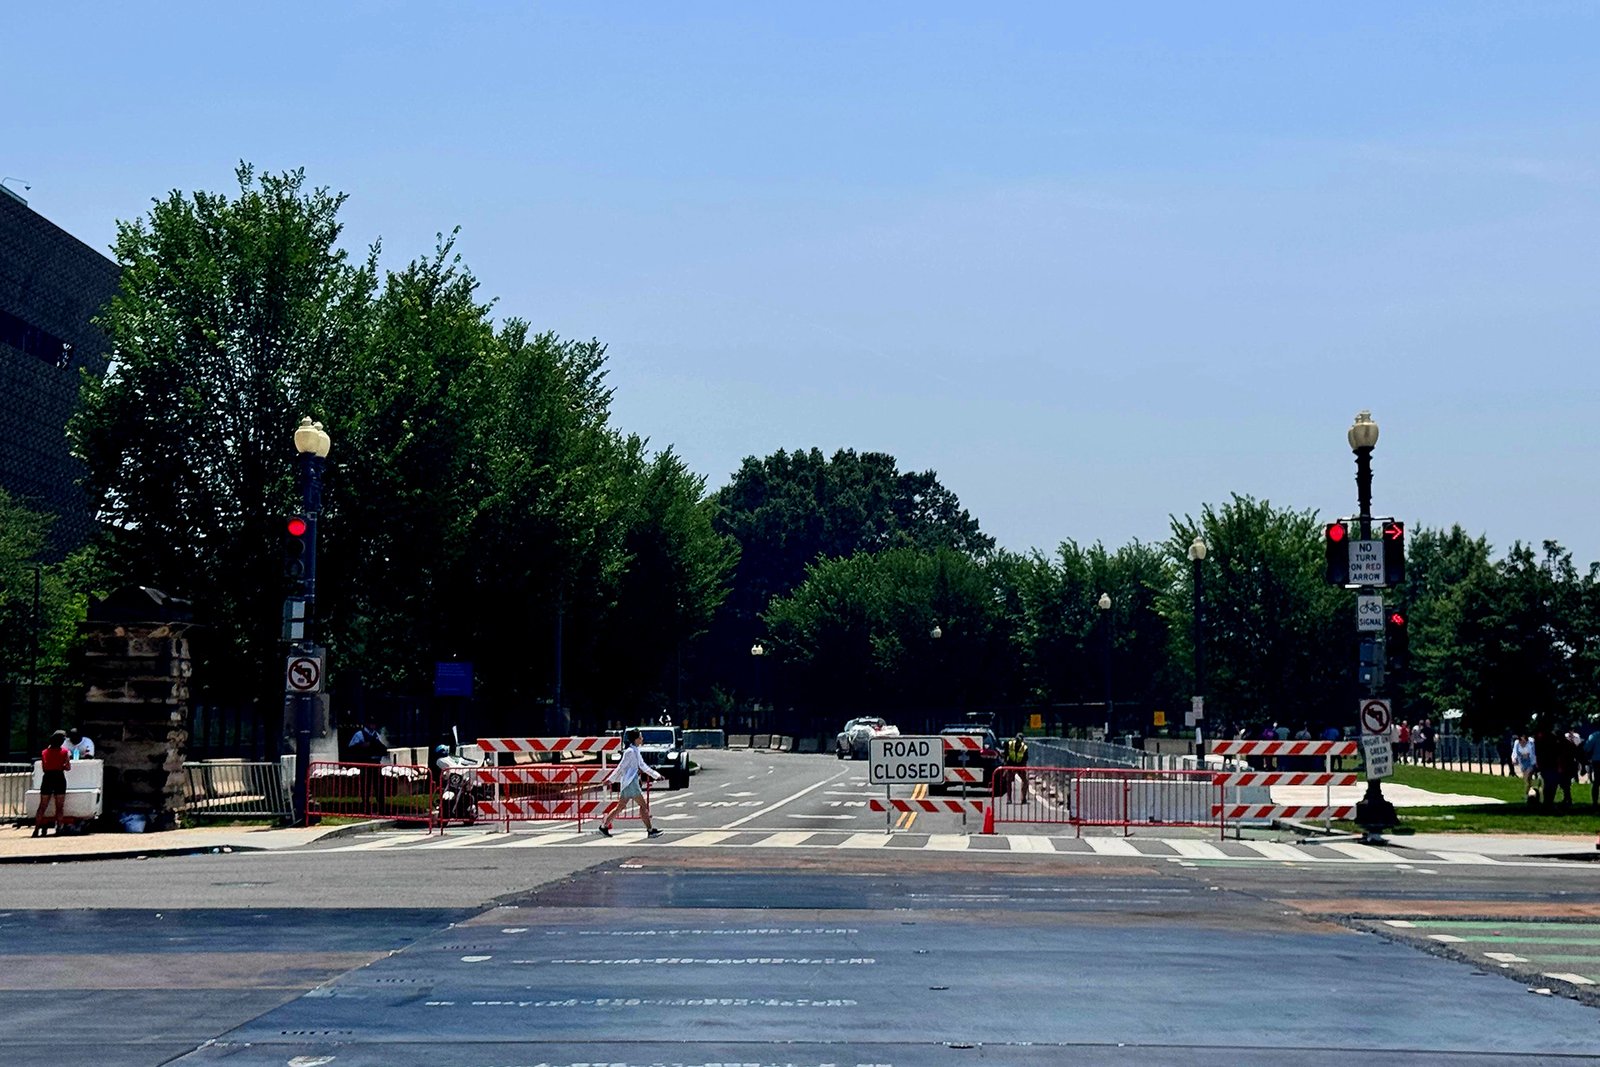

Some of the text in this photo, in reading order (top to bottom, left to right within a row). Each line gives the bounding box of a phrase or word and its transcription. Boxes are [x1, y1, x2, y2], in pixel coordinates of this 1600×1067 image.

[1359, 543, 1372, 552] NO
[1351, 563, 1381, 571] ON RED
[1359, 618, 1382, 626] SIGNAL
[883, 741, 930, 757] ROAD
[874, 763, 940, 779] CLOSED
